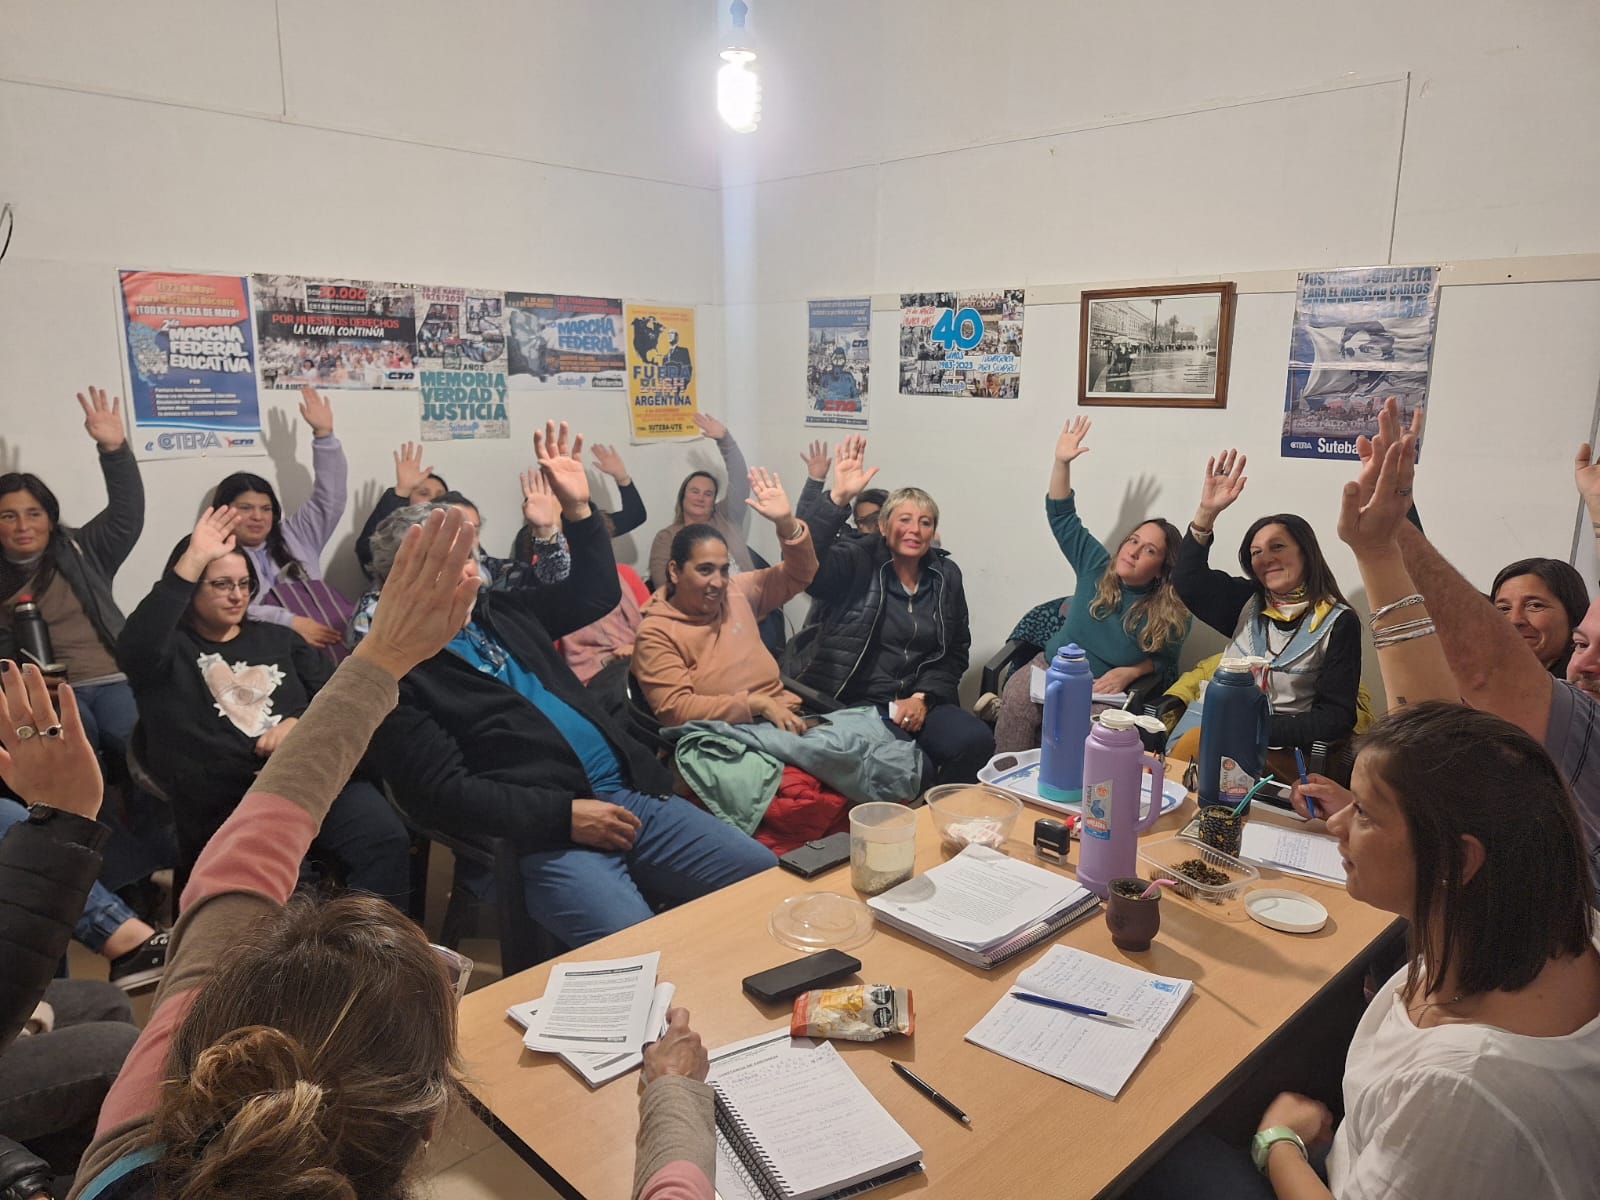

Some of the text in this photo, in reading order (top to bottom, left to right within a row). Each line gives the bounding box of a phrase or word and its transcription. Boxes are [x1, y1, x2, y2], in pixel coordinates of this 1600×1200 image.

[319, 286, 368, 301] 30.000
[1328, 286, 1339, 297] EL
[1389, 282, 1430, 295] CARLOS
[176, 306, 202, 317] PLAZA
[272, 314, 399, 328] POR NUESTROS DERECHOS
[558, 317, 615, 337] MARCHA
[931, 307, 984, 350] 40
[169, 325, 245, 343] MARCHA
[293, 324, 385, 337] LA LUCHA CONTINÚA
[169, 341, 249, 357] FEDERAL
[558, 335, 619, 352] FEDERAL
[169, 354, 252, 373] EDUCATIVA
[420, 371, 507, 388] MEMORIA
[633, 366, 691, 380] FUERA
[420, 387, 508, 403] VERDAD Y
[634, 395, 692, 406] ARGENTINA
[421, 403, 508, 421] JUSTICIA
[1317, 437, 1360, 454] Suteba
